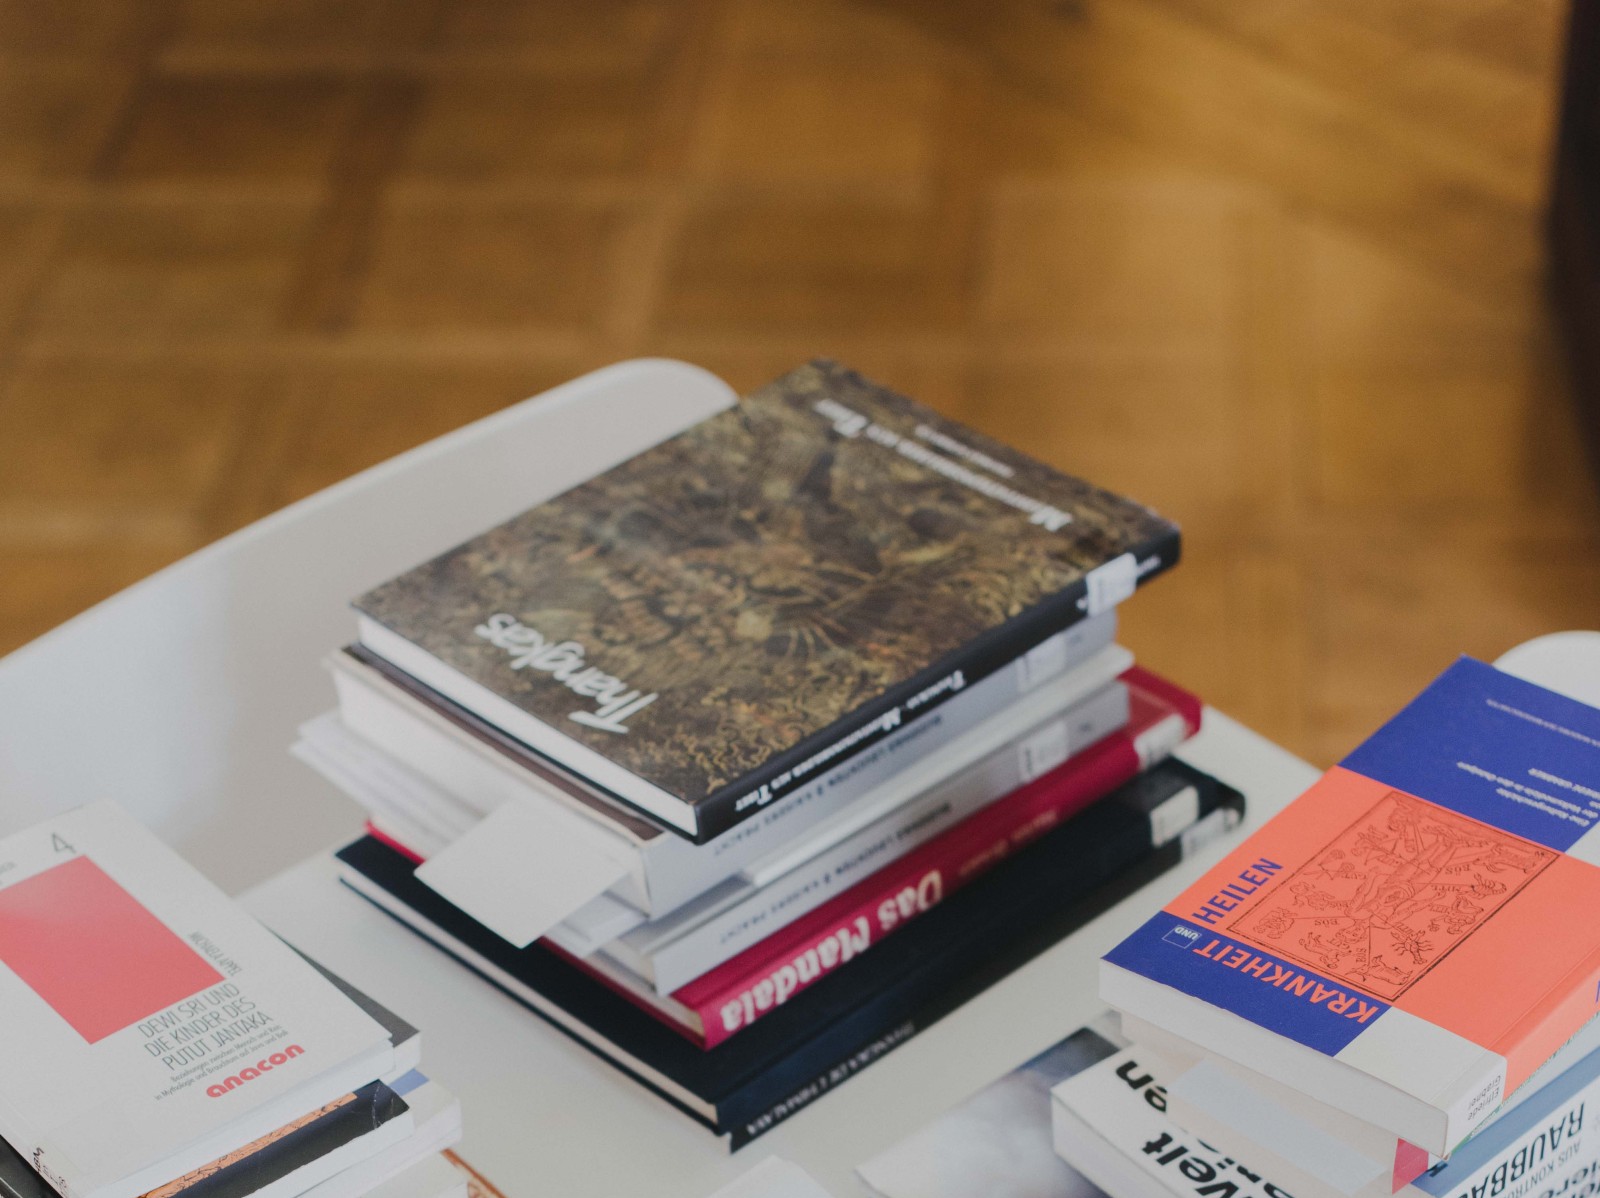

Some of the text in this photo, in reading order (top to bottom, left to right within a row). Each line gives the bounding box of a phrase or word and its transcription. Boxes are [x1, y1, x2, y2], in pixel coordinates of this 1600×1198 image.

[474, 613, 658, 733] Thangkas
[51, 831, 77, 854] 4
[1192, 857, 1284, 925] HEILEN
[719, 869, 944, 1031] Das Mandala
[1174, 924, 1202, 940] UND
[138, 982, 240, 1038] DEWI SRI UND
[1192, 939, 1380, 1024] KRANKHEIT
[144, 996, 256, 1057] DIE KINDER DES
[161, 1010, 275, 1071] PUTUT JANTAKA
[206, 1044, 306, 1098] anacon
[1467, 1086, 1500, 1121] Elfriede
[1558, 1138, 1582, 1166] AUS
